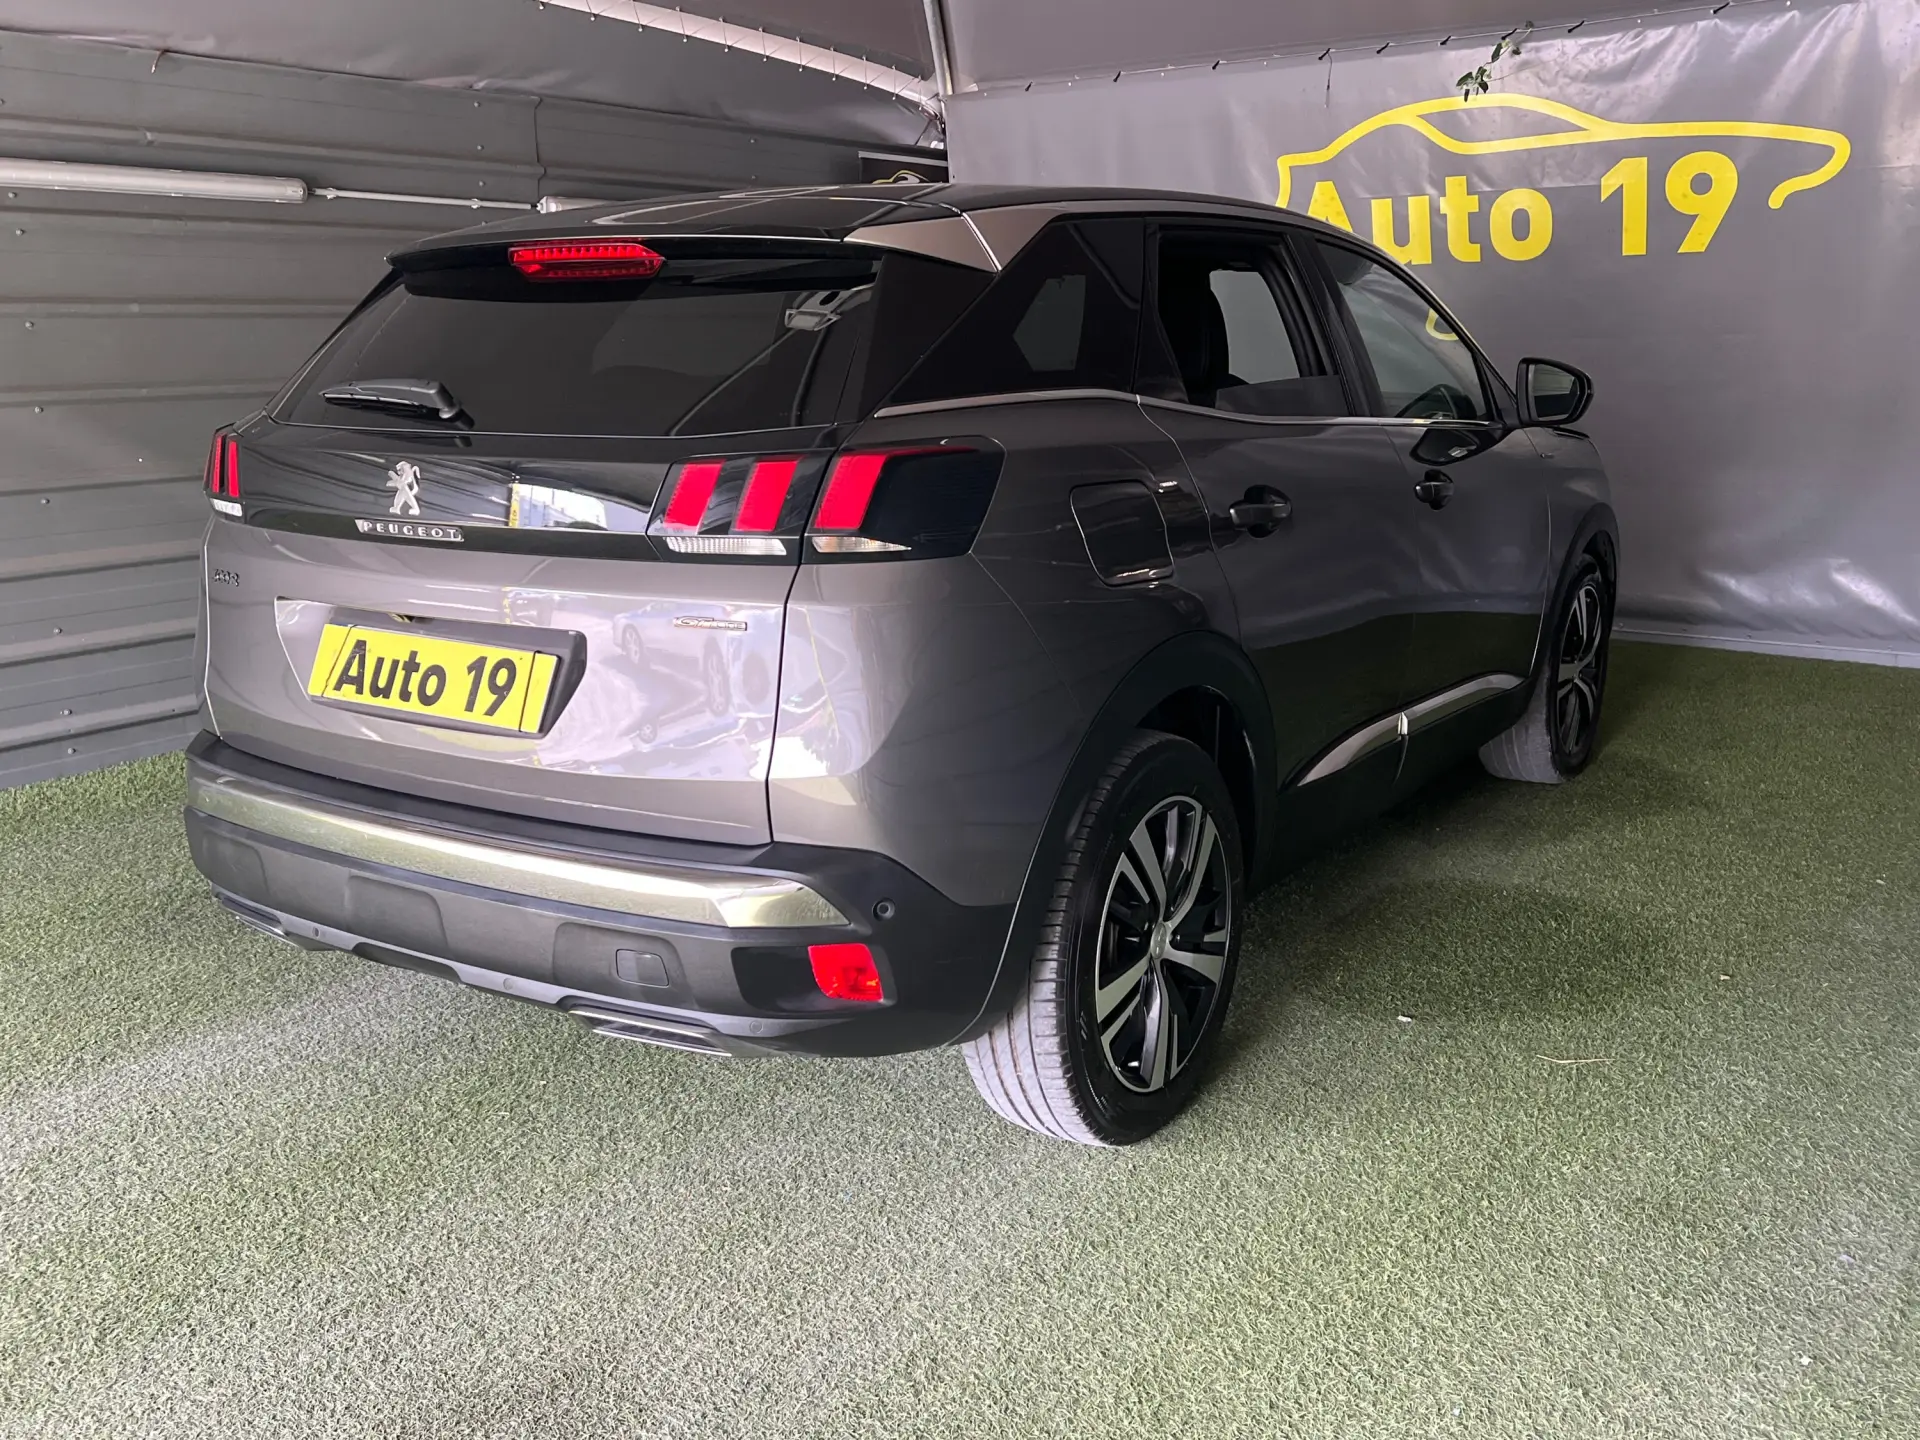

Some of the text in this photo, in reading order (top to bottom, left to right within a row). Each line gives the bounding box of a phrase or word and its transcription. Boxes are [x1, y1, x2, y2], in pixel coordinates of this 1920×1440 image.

[1307, 150, 1739, 266] Auto 19
[363, 521, 457, 540] PEUGEOT
[333, 639, 517, 717] Auto 19
